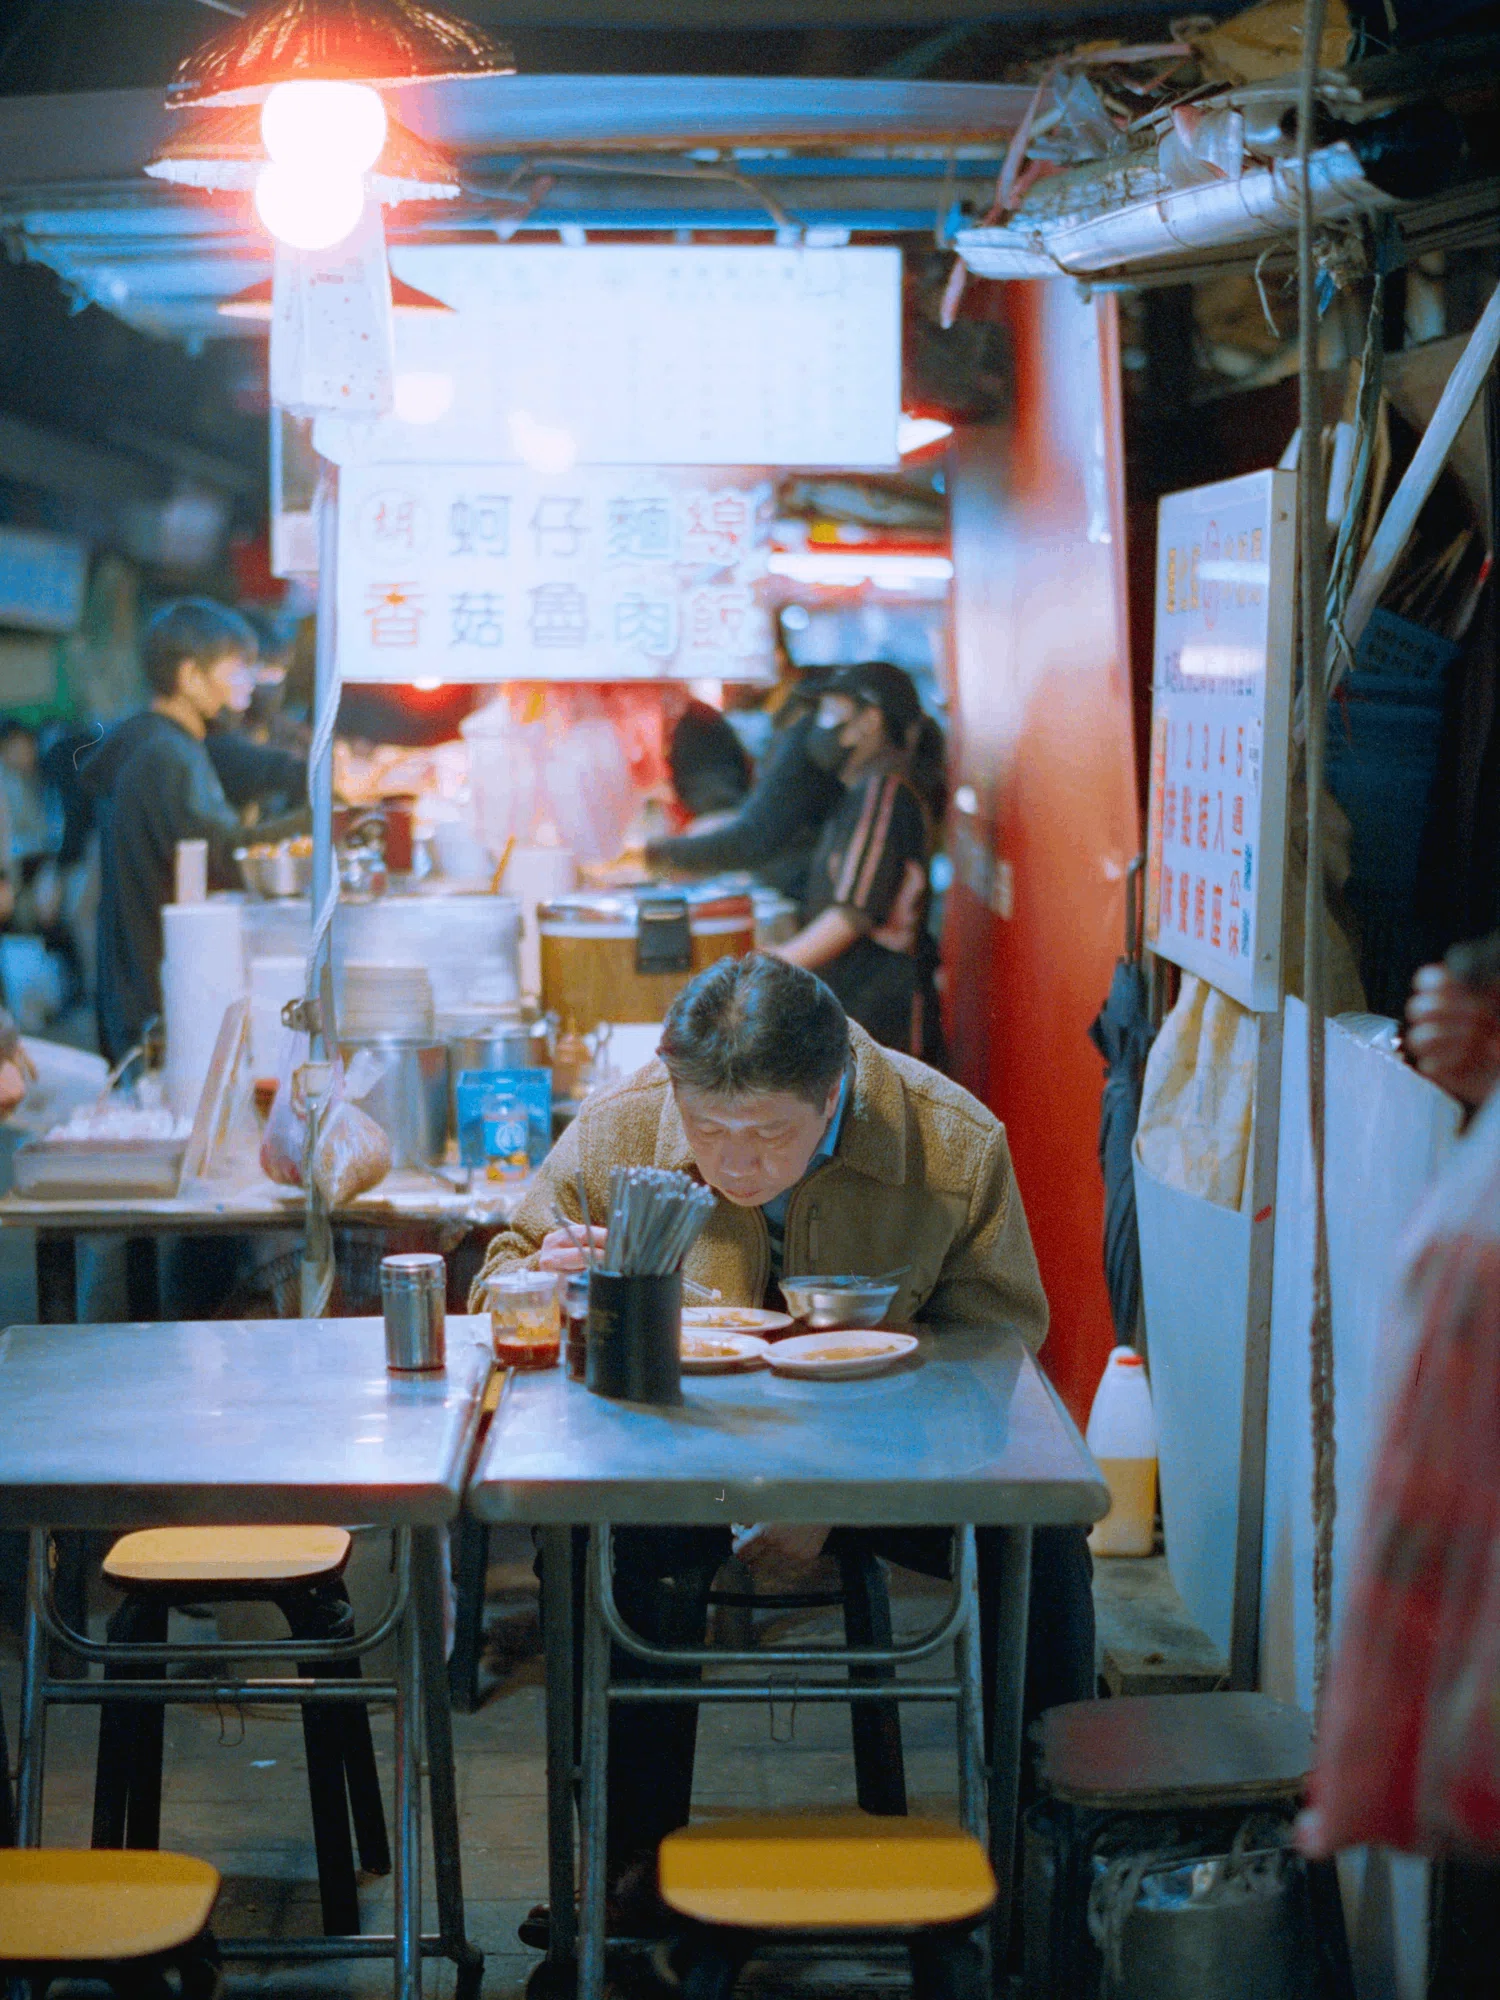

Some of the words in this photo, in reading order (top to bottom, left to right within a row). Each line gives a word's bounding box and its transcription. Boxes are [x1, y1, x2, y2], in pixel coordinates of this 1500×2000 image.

[364, 581, 748, 656] 香菇魯肉飯
